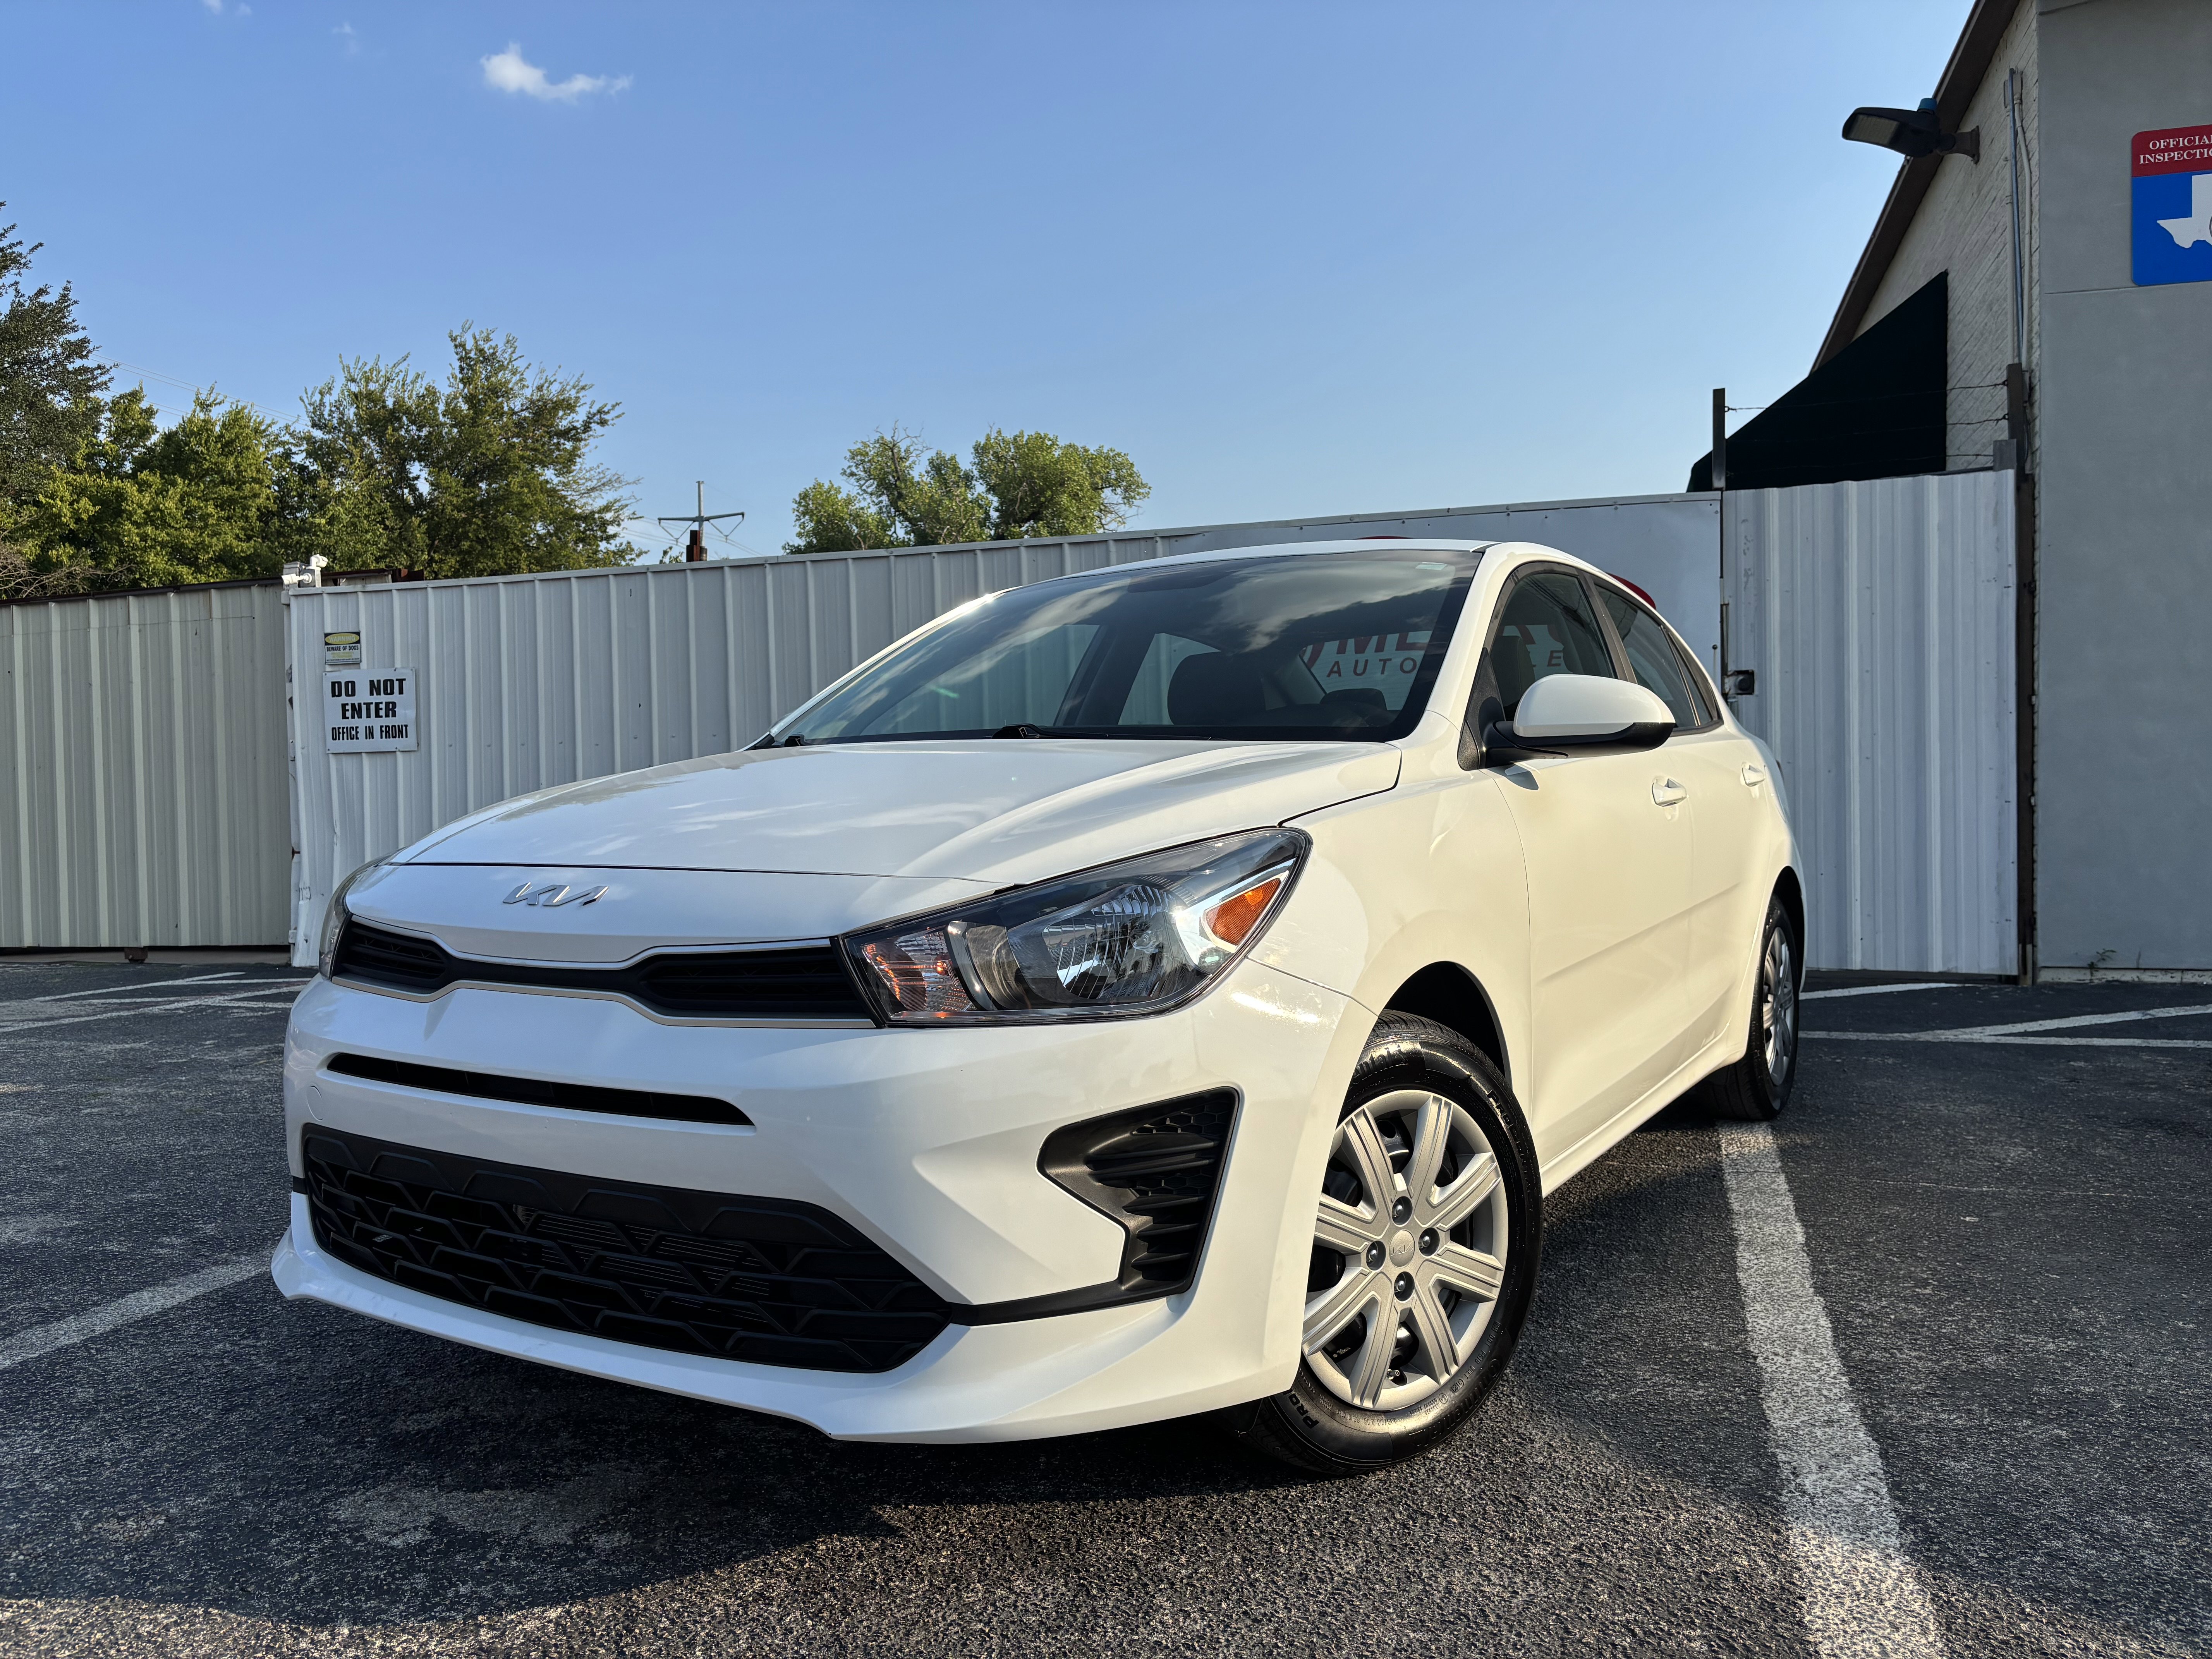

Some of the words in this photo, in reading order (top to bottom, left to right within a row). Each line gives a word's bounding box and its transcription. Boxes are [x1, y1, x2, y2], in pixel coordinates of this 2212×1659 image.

[331, 680, 356, 698] DO
[369, 678, 406, 696] NOT
[341, 701, 397, 720] ENTER
[331, 726, 359, 741] OFFICE
[365, 725, 374, 740] IN
[380, 724, 409, 739] FRONT
